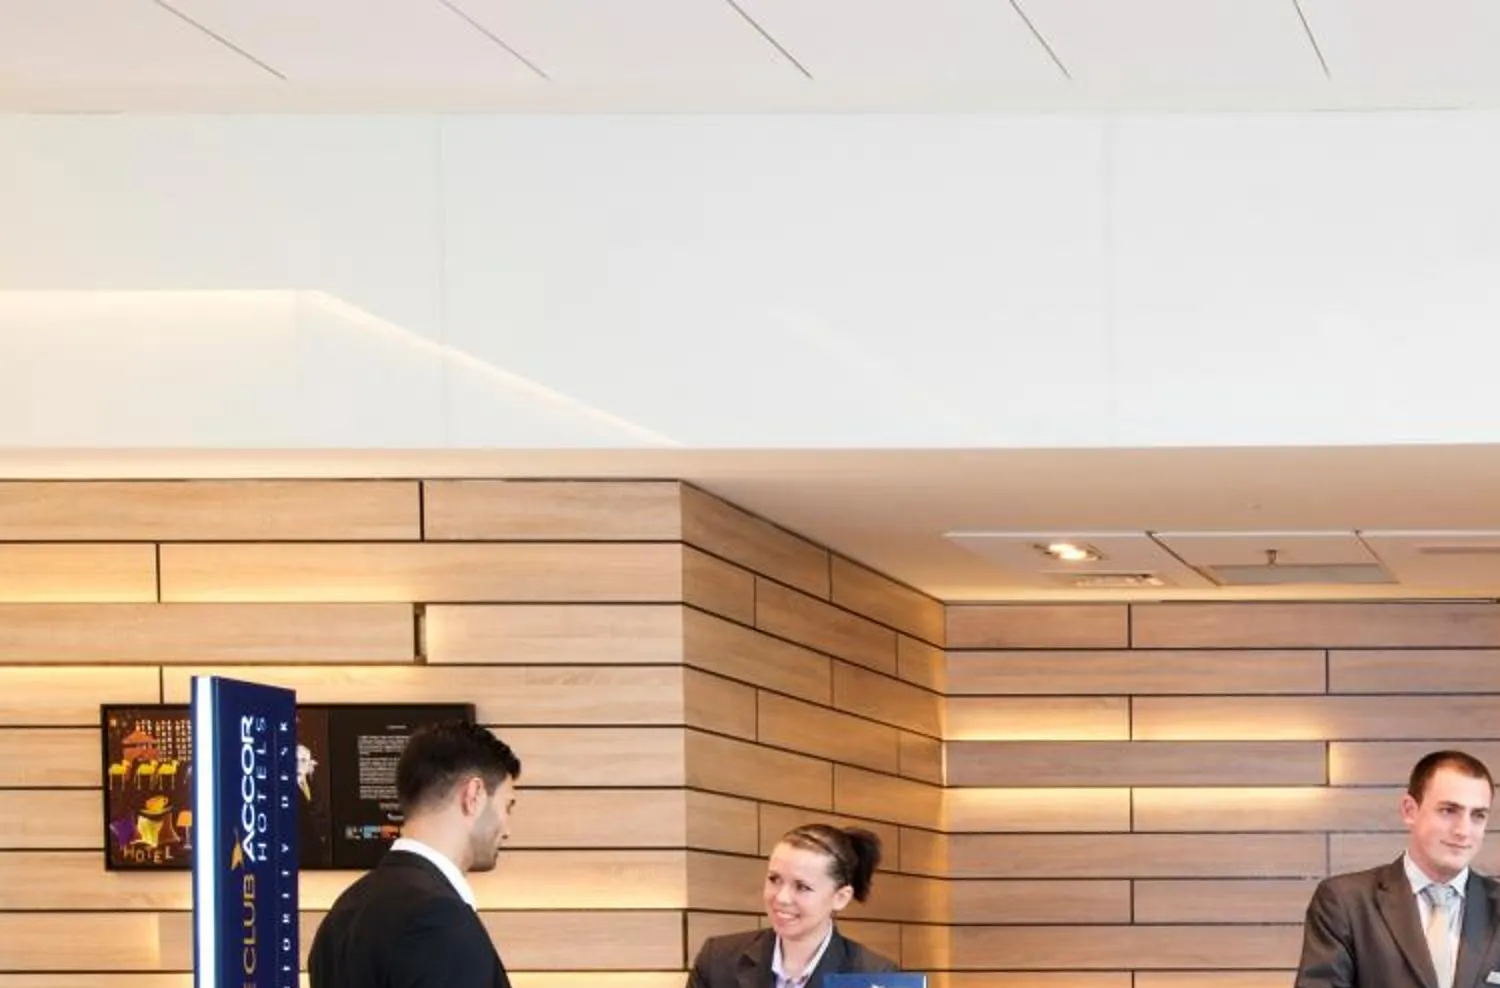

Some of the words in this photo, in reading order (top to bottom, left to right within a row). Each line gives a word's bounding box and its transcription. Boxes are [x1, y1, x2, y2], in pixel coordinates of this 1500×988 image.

[241, 715, 256, 863] ACCOR
[256, 717, 268, 861] HOTELS
[123, 846, 174, 863] HOTEL
[243, 873, 257, 975] CLUB
